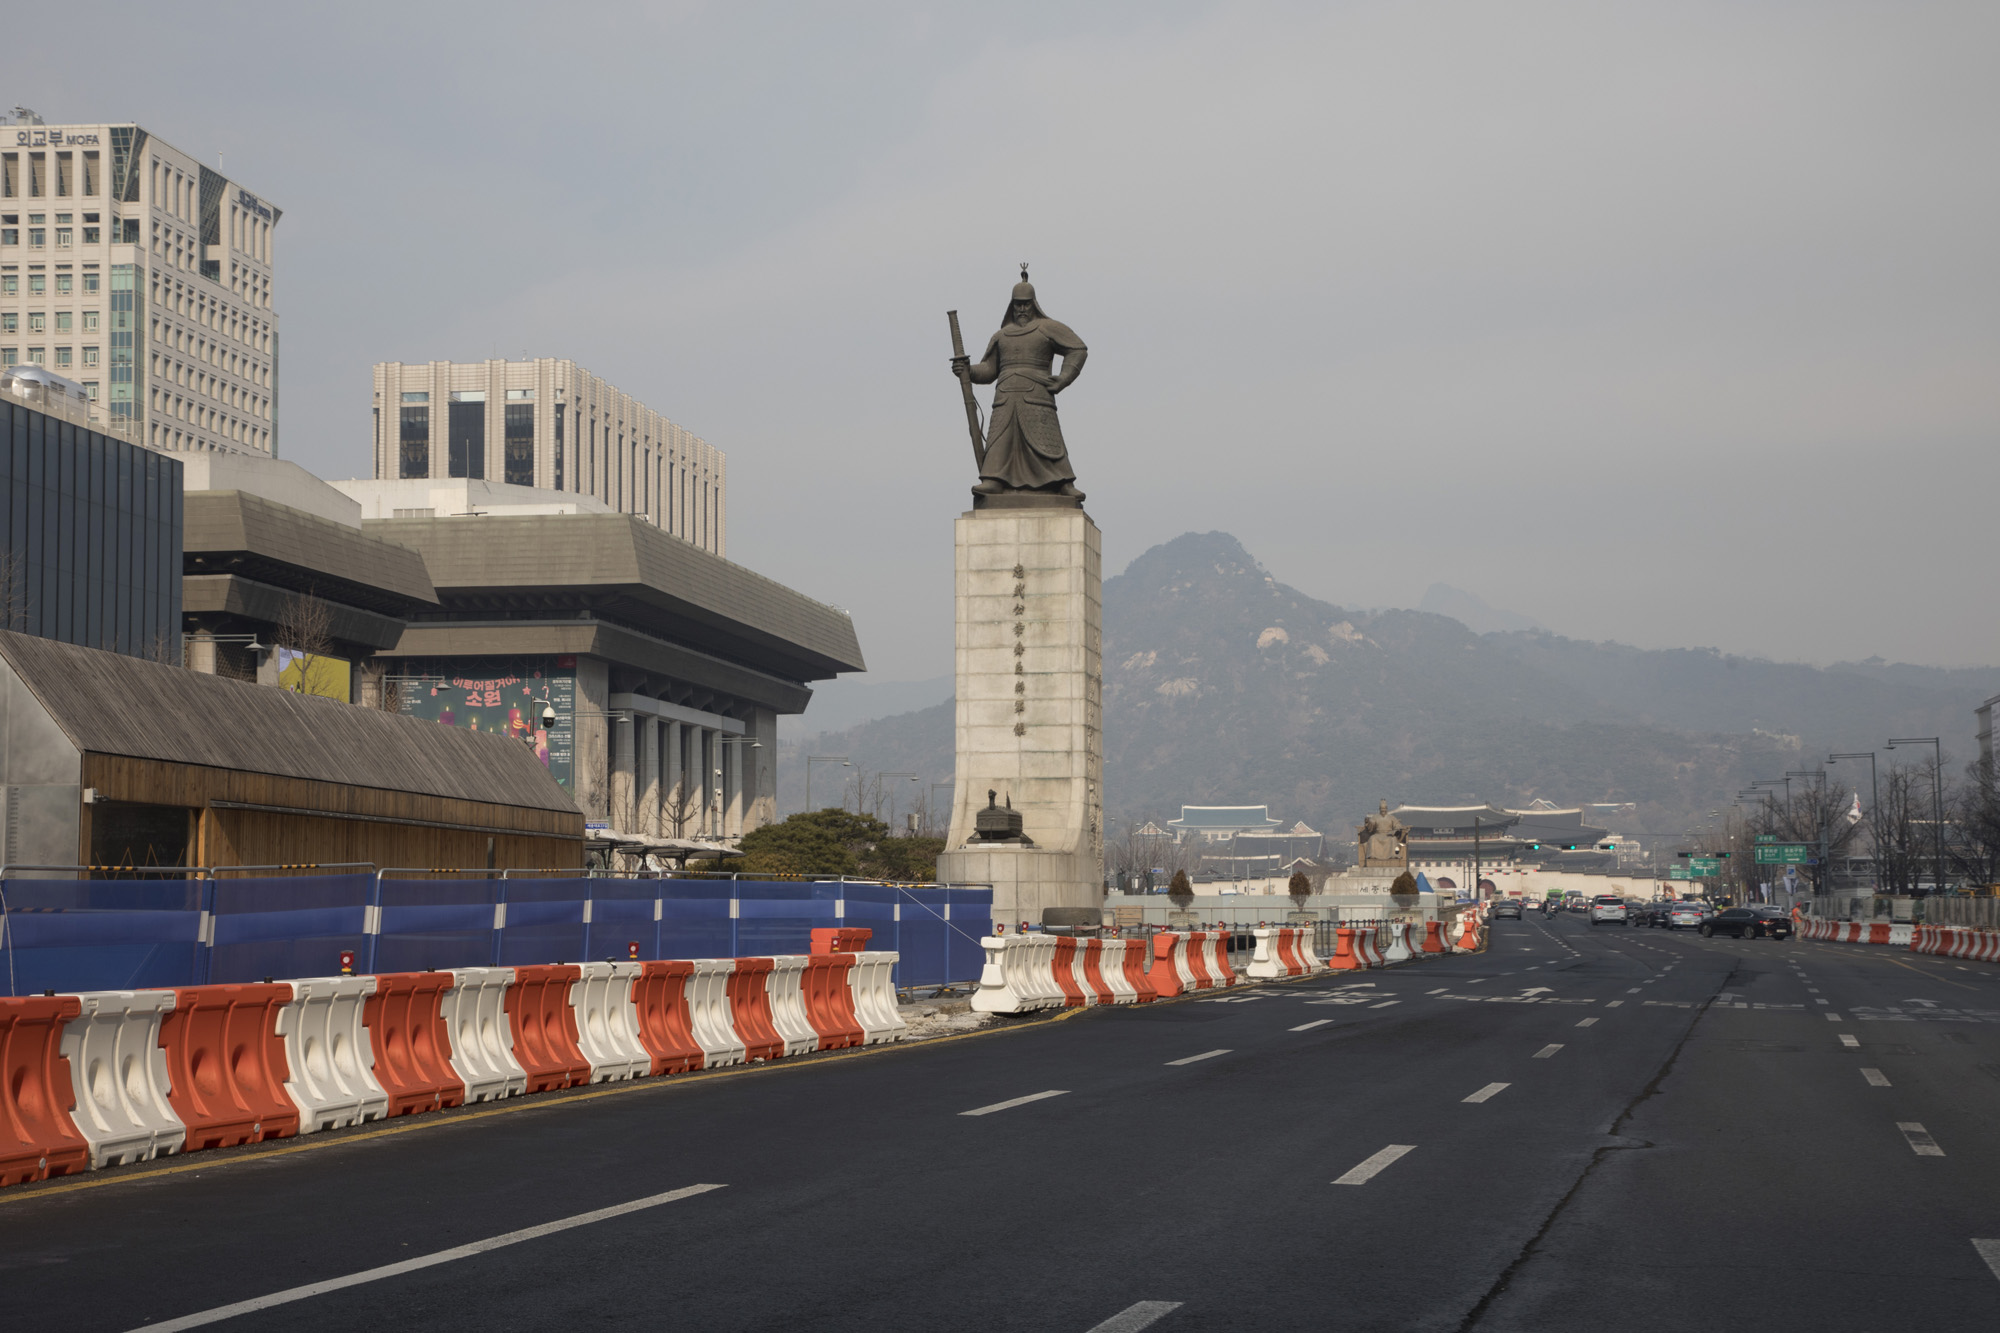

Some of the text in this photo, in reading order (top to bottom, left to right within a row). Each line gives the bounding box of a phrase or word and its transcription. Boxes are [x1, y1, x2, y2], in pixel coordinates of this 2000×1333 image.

[16, 130, 99, 147] 외교부 MOFA
[465, 689, 502, 708] 소원
